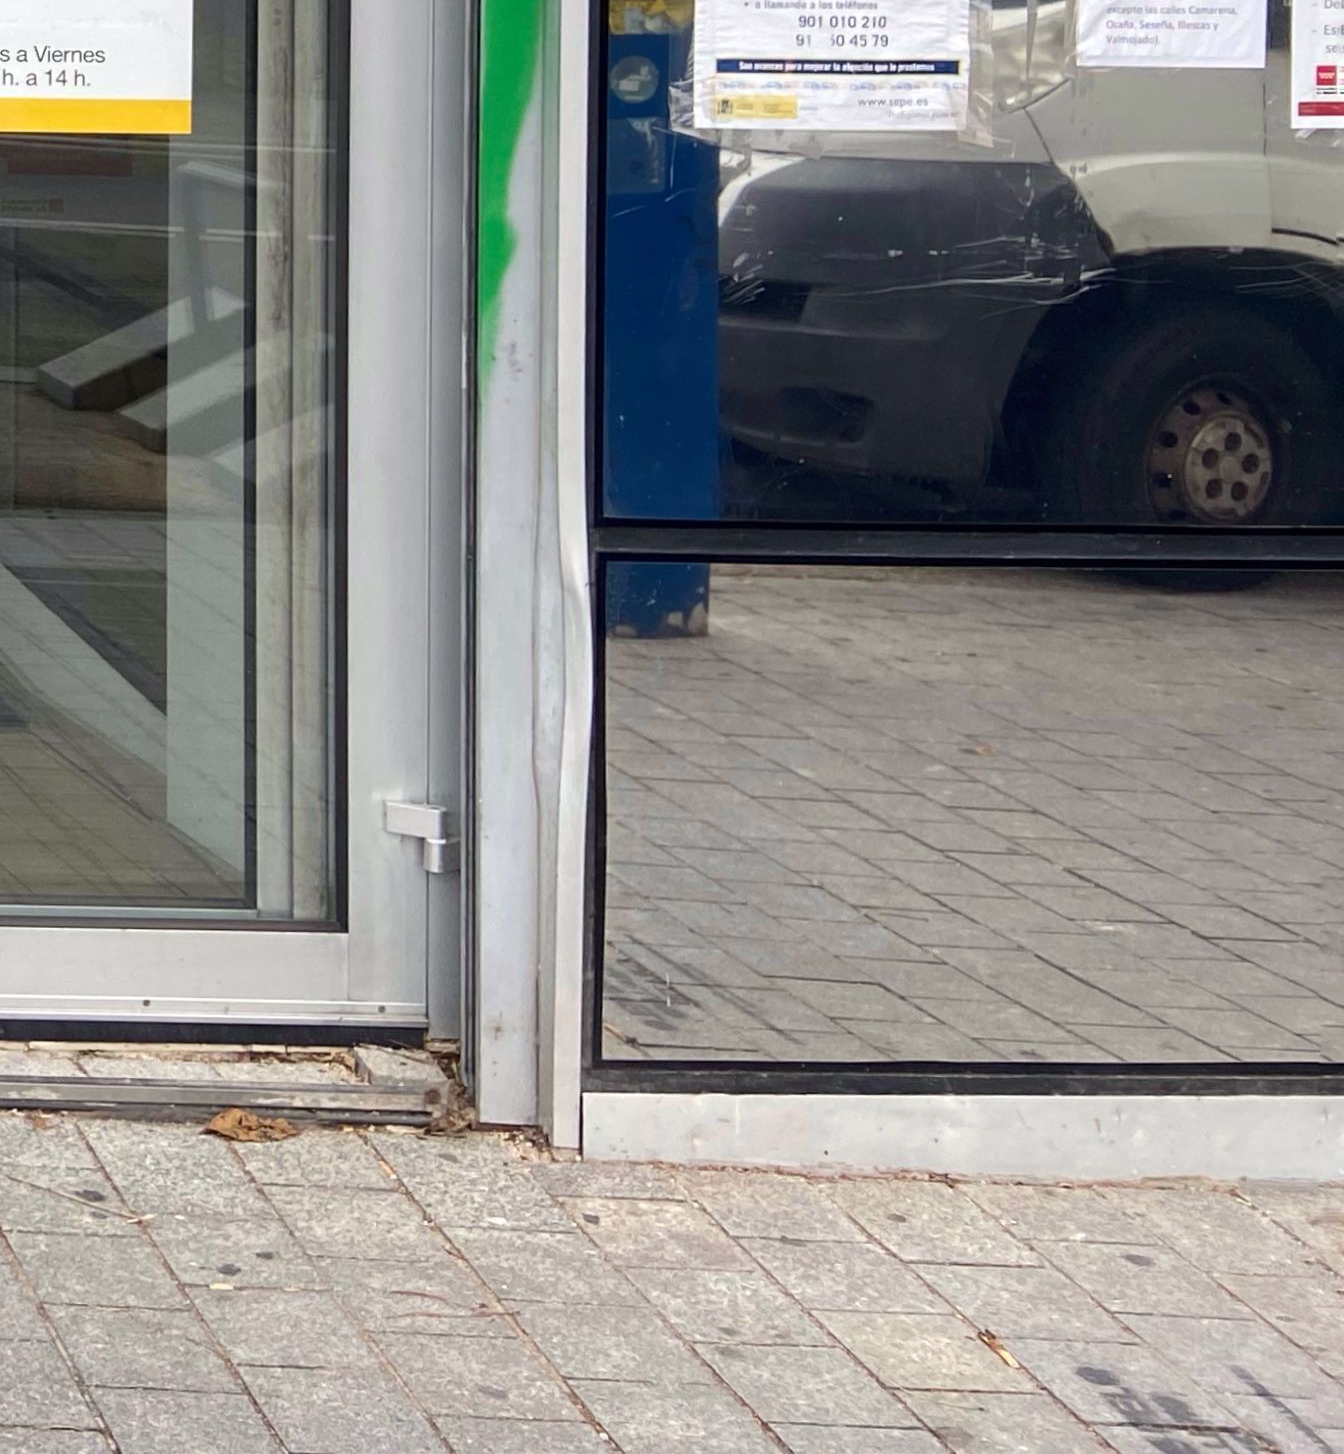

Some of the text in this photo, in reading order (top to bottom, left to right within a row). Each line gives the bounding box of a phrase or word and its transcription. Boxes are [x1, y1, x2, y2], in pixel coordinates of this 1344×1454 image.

[798, 15, 887, 28] 901 010 210
[16, 49, 28, 62] a
[33, 45, 105, 63] Viernes
[2, 68, 19, 85] h.
[26, 72, 37, 86] a
[44, 69, 67, 86] 14
[74, 69, 90, 86] h.
